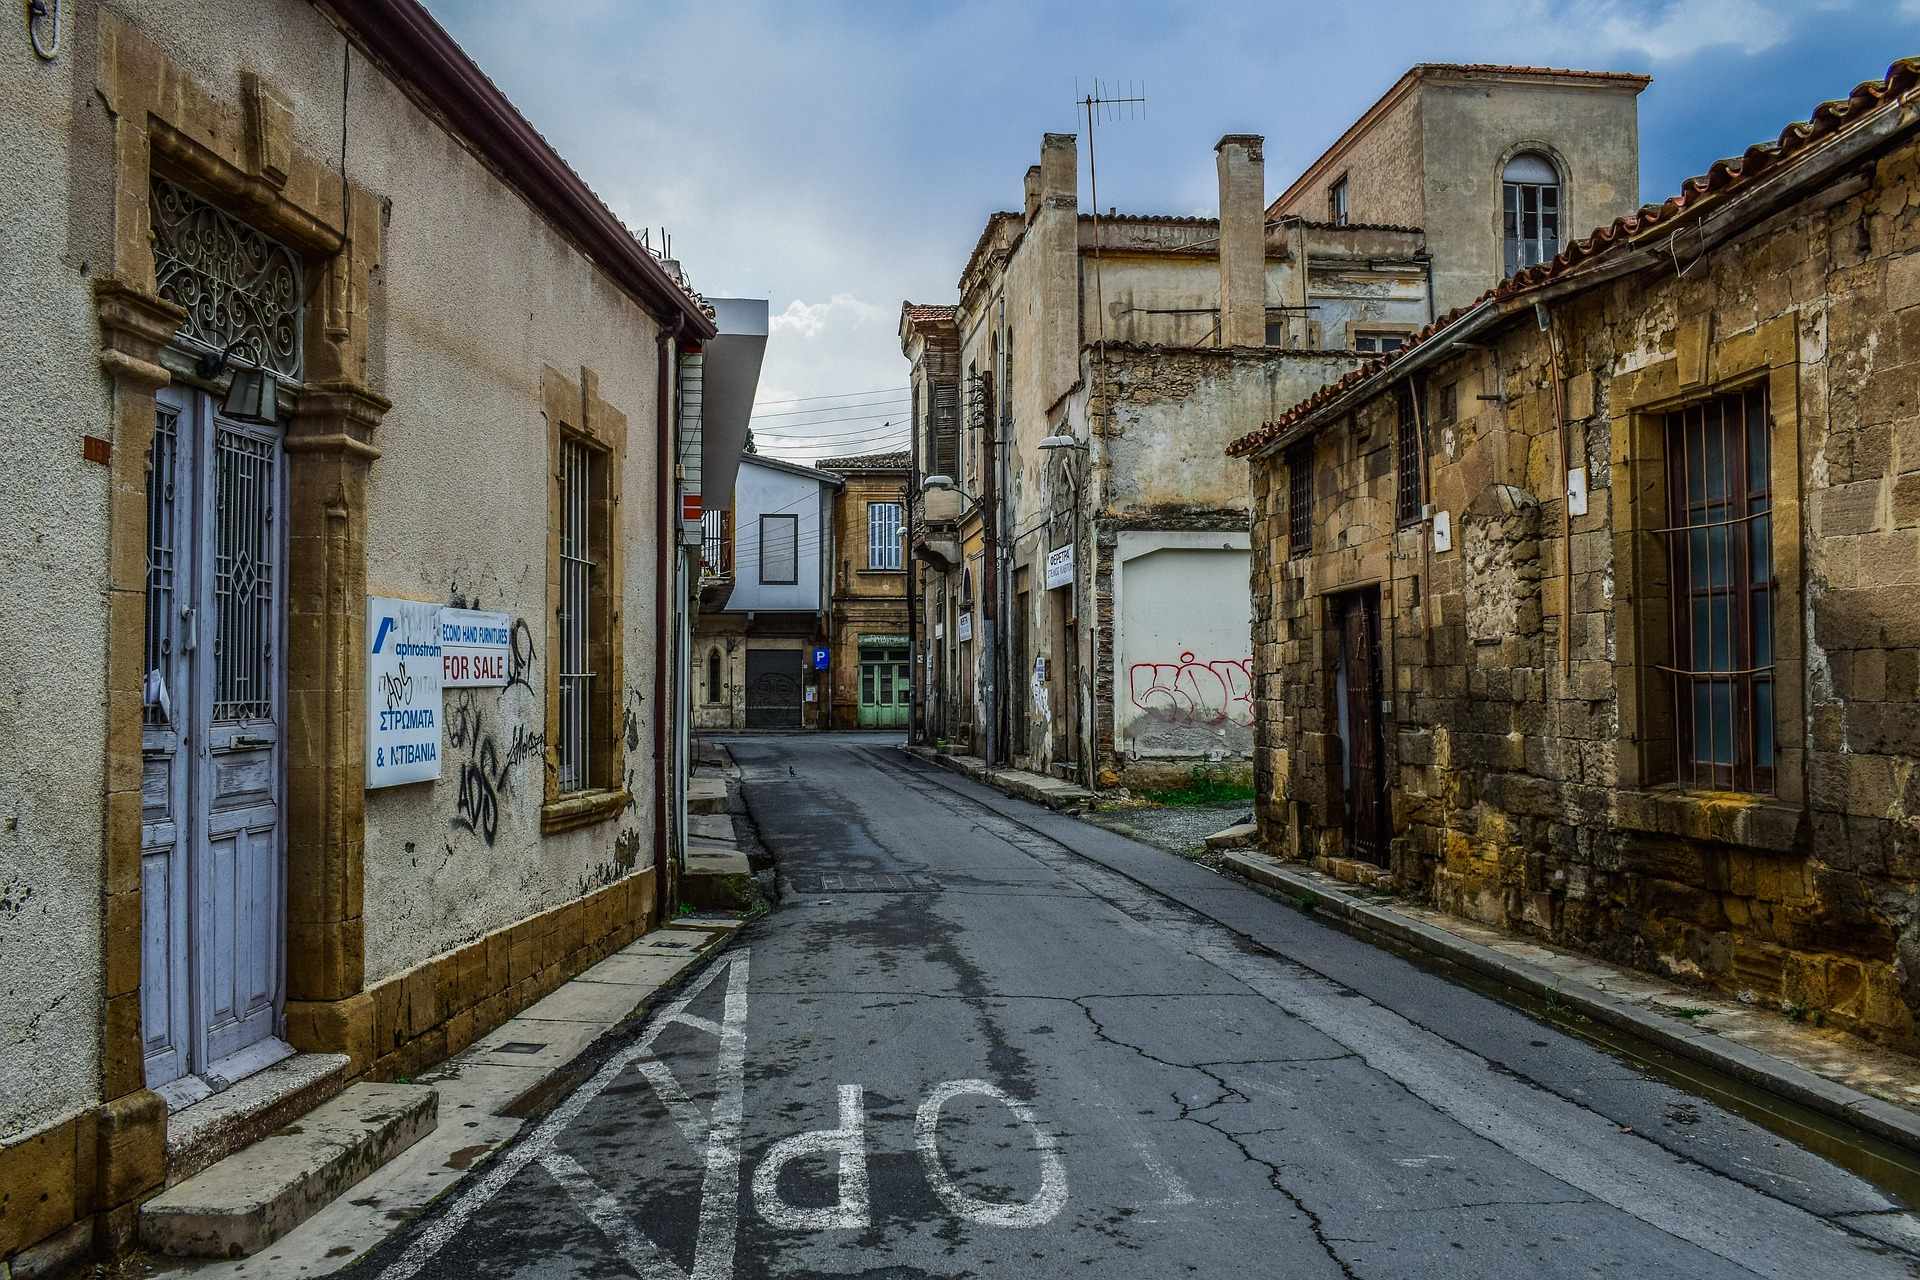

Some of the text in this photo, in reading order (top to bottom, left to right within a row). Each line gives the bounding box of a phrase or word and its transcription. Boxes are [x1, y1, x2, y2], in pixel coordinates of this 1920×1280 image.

[462, 625, 478, 643] HAND
[479, 626, 508, 645] FURNITURES
[395, 636, 442, 661] aphrostrom
[816, 651, 825, 662] P
[443, 655, 503, 680] FOR SALE
[380, 709, 435, 731] ΣΤΡΩΜΑΤΑ
[376, 747, 385, 768] &
